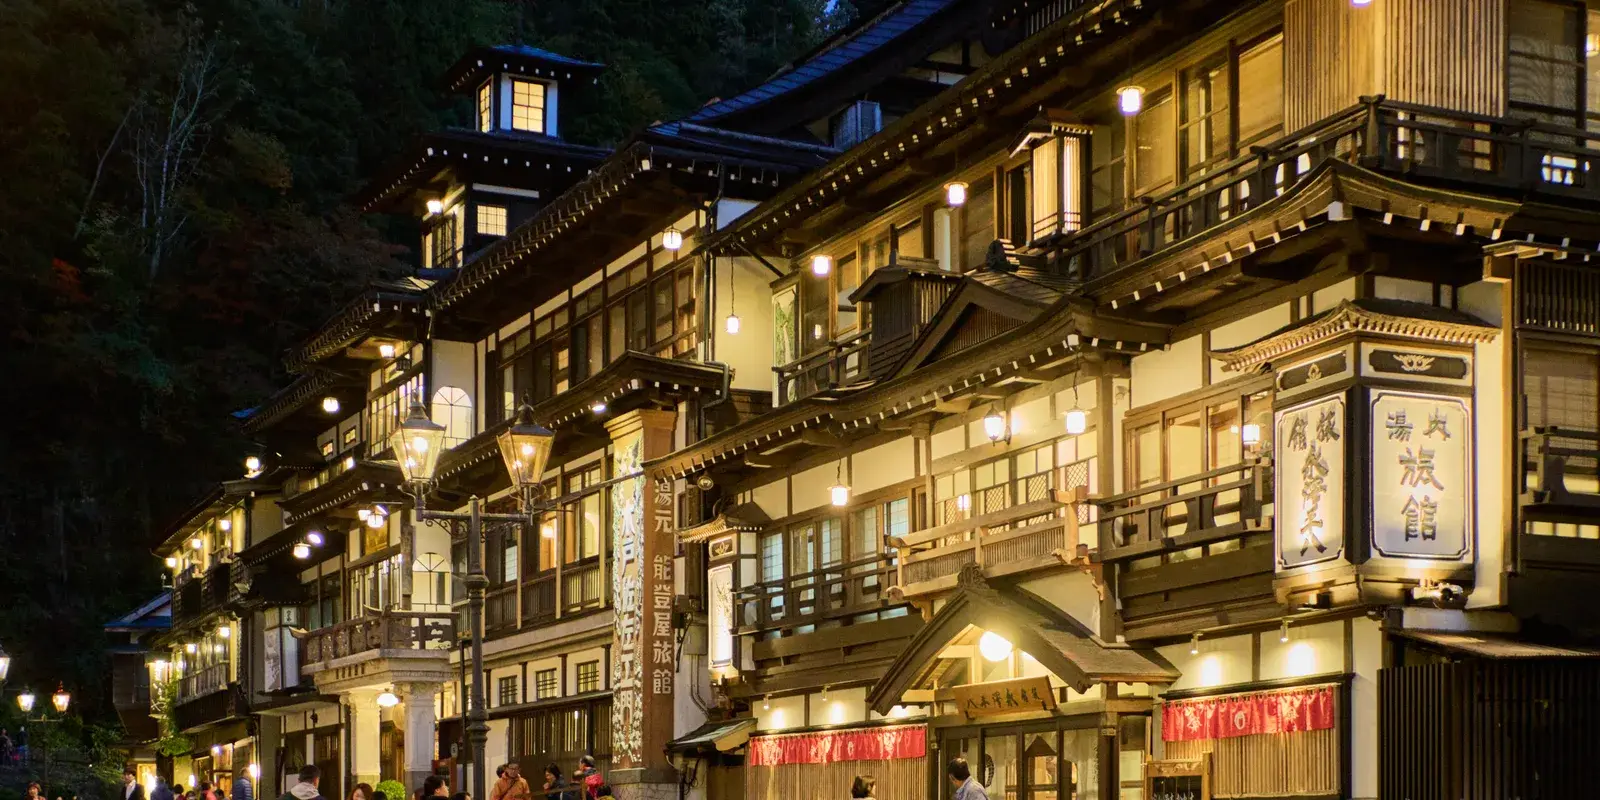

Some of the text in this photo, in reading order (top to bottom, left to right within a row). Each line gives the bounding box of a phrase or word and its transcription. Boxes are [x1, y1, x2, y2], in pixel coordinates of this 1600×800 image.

[1398, 446, 1444, 542] 旅館
[653, 482, 673, 695] 湯元 能登屋旅館
